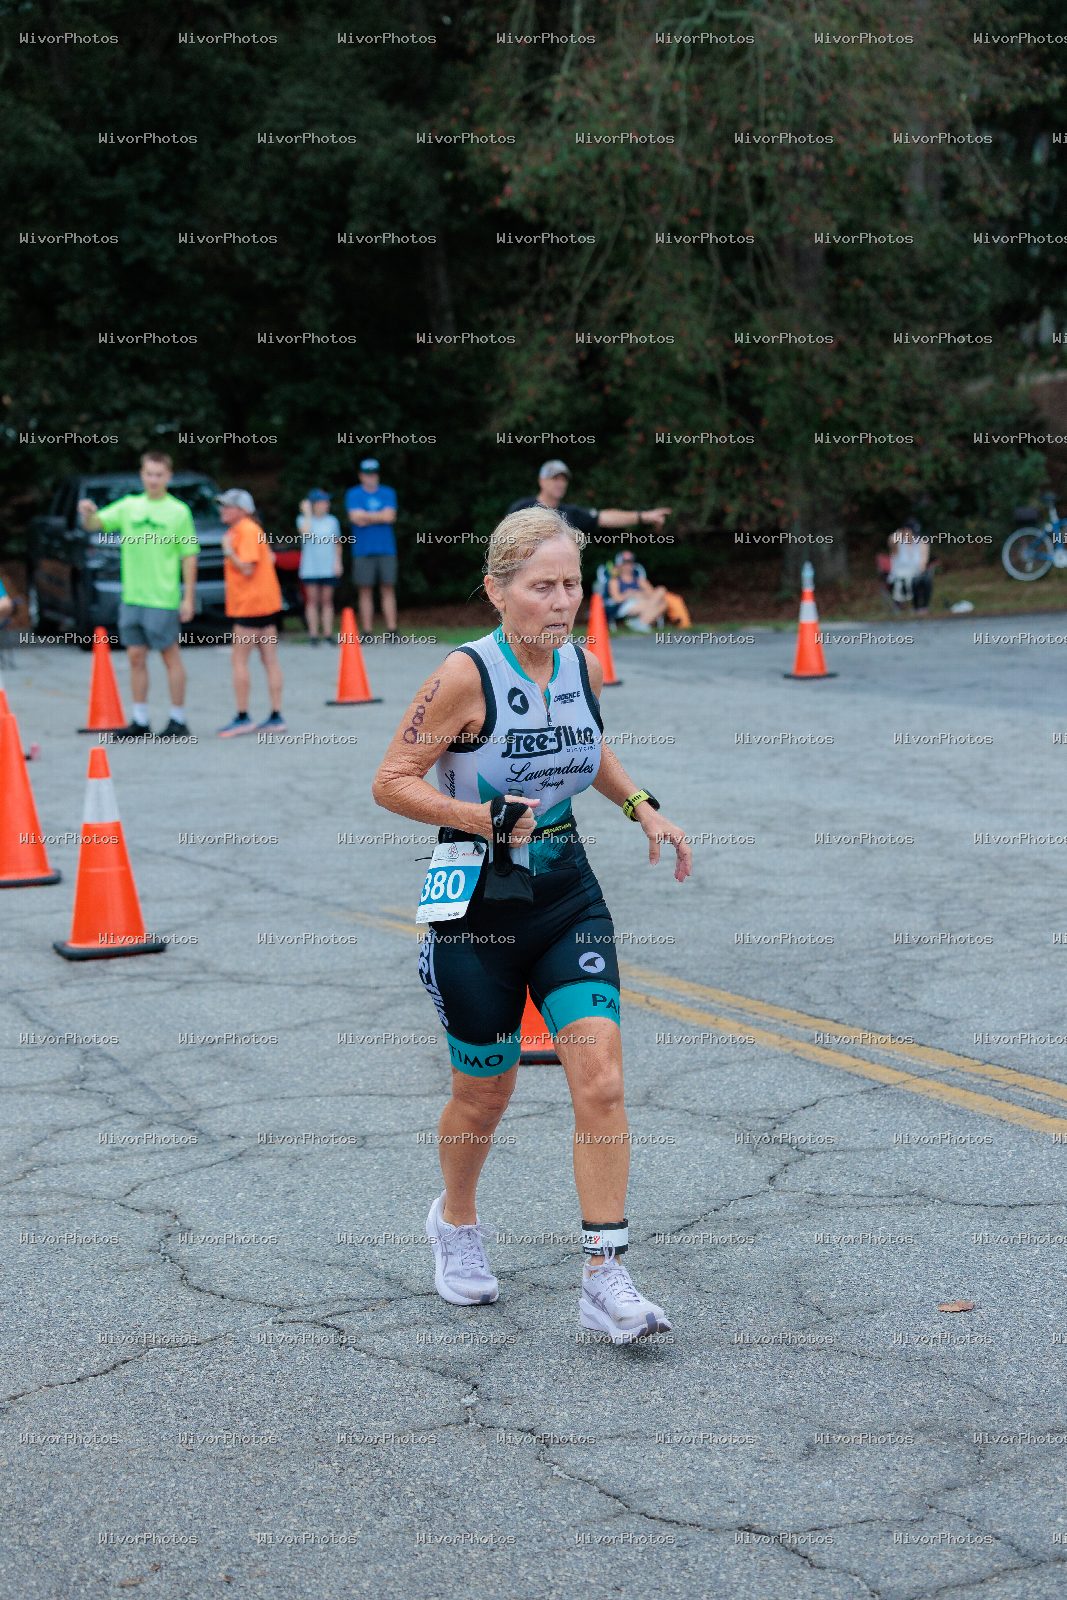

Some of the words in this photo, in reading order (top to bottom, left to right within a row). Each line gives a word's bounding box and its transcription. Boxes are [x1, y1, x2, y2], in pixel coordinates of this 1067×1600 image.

[554, 691, 581, 702] CADENCE
[505, 757, 594, 783] Lawandales
[444, 769, 456, 798] dales
[420, 869, 466, 903] 380
[591, 993, 620, 1015] PA
